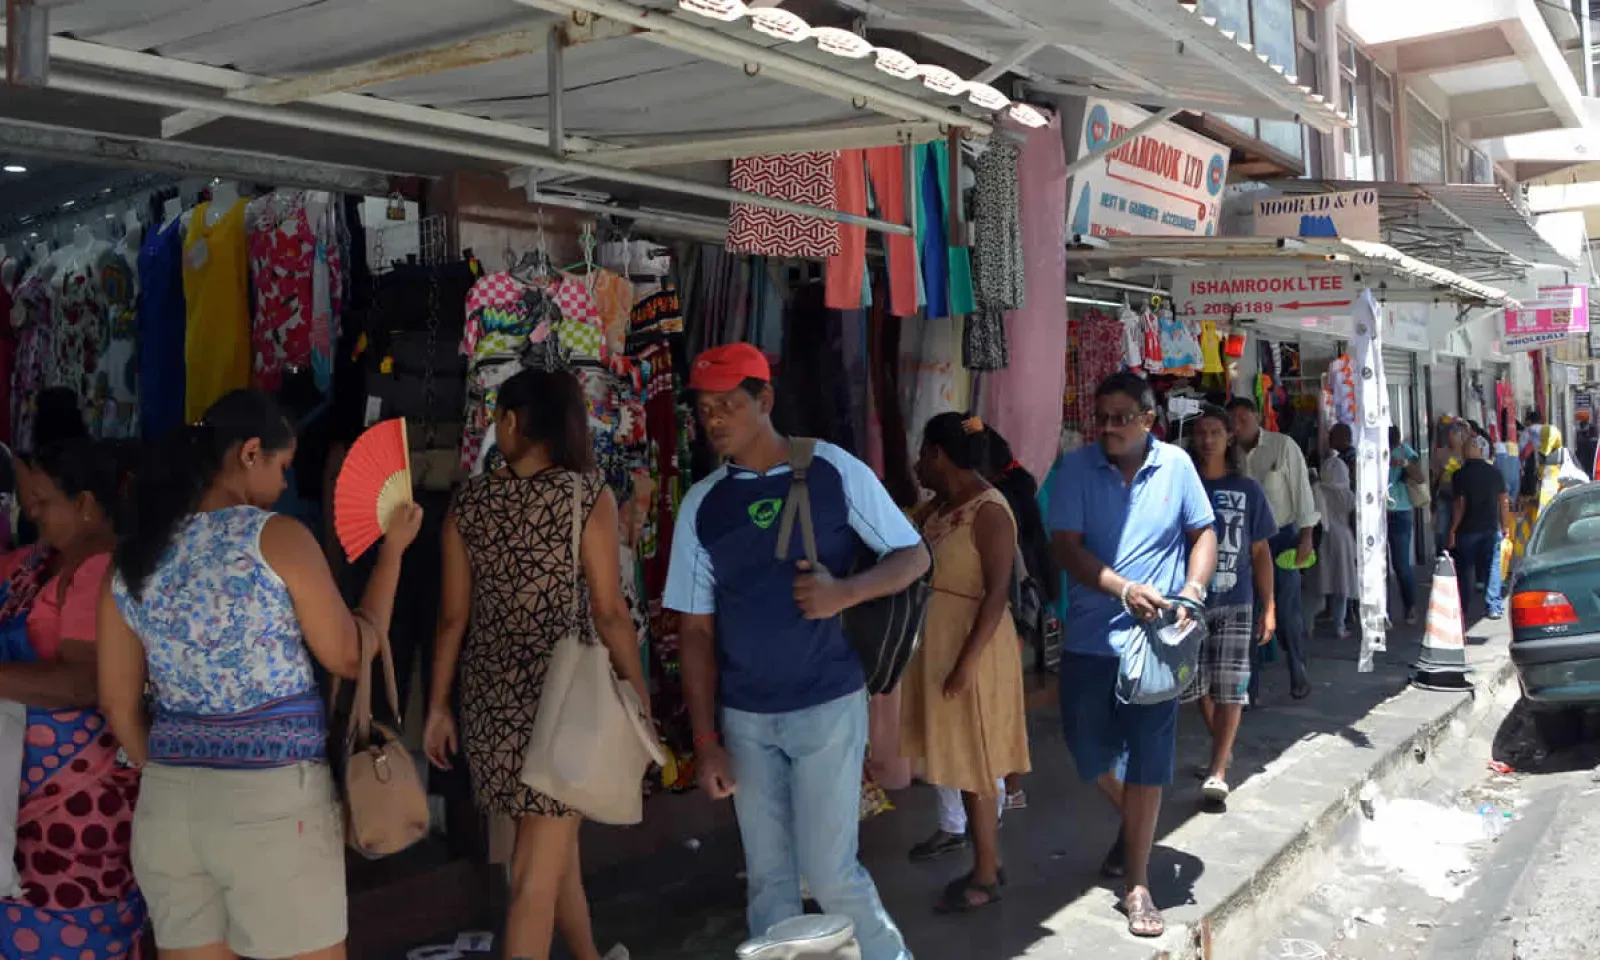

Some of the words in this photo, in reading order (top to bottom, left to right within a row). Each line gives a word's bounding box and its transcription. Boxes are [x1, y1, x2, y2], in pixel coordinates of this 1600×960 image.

[1183, 153, 1203, 189] LTD
[1258, 196, 1330, 216] MOORAD
[1334, 195, 1349, 209] &
[1352, 191, 1375, 207] CO
[1190, 278, 1295, 296] ISHAMROOK
[1299, 275, 1344, 291] LTEE
